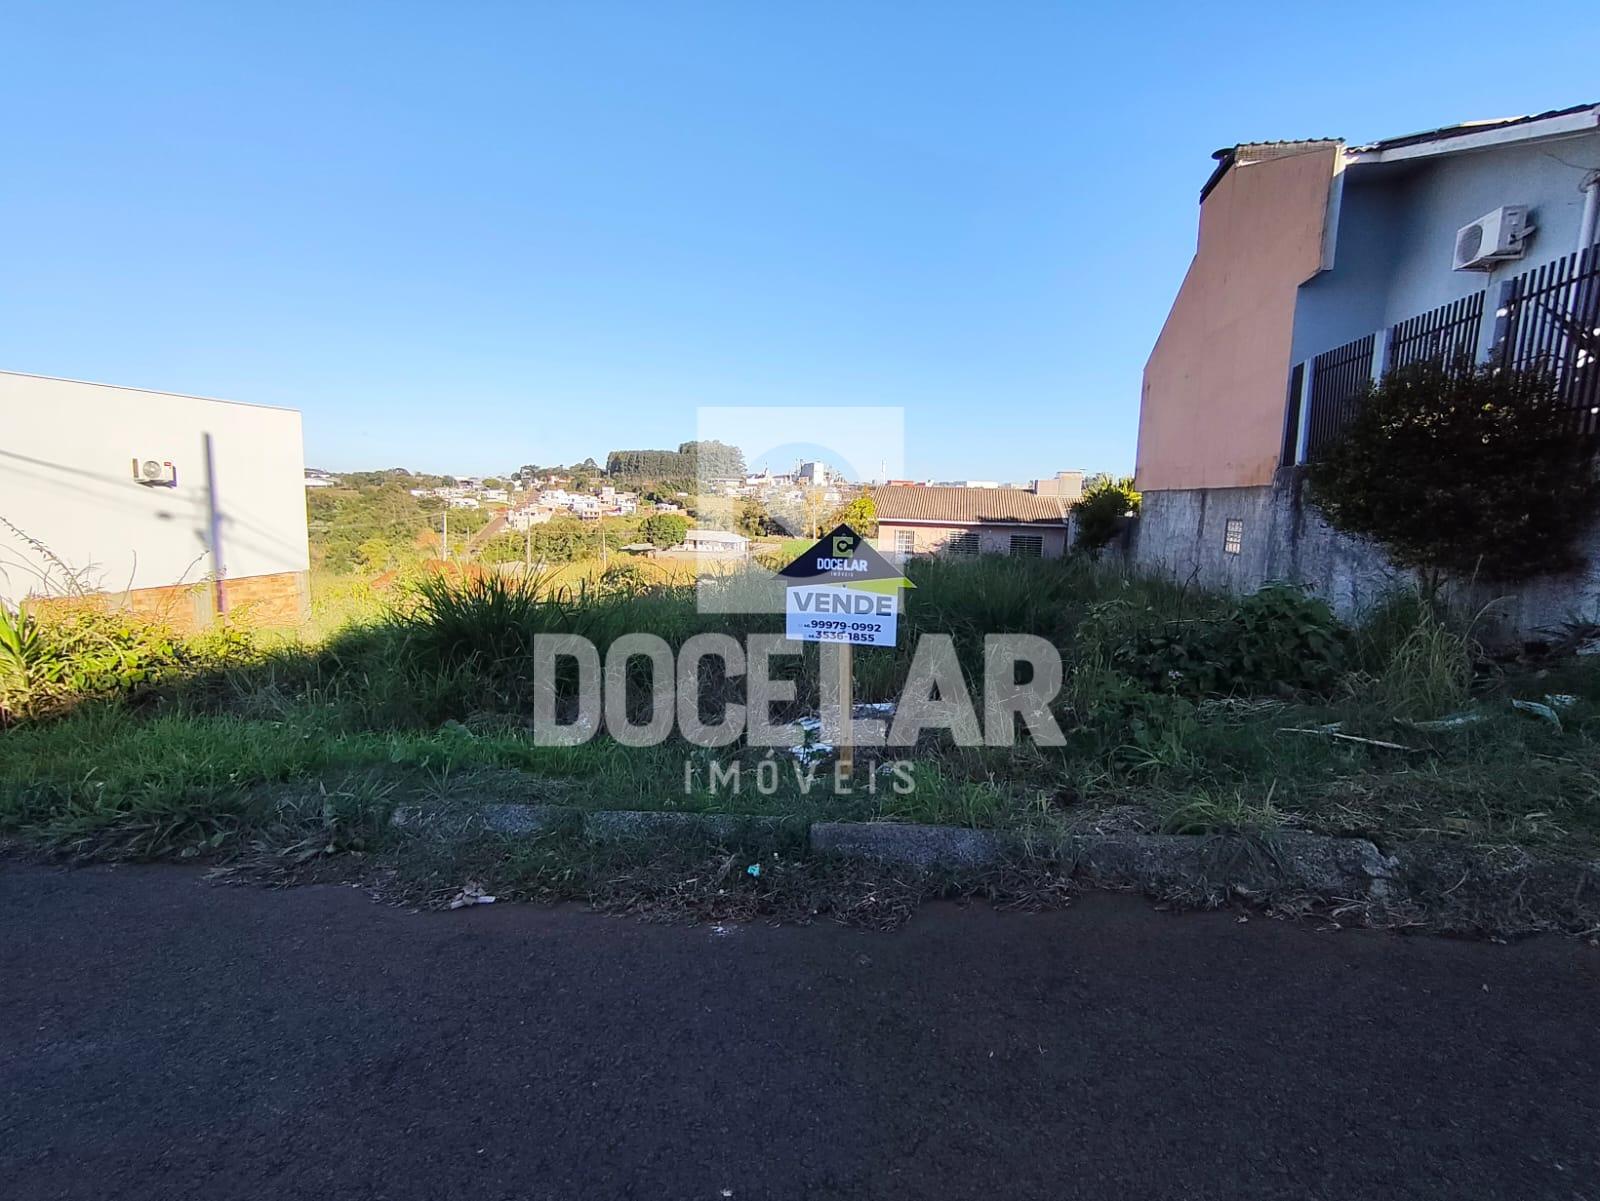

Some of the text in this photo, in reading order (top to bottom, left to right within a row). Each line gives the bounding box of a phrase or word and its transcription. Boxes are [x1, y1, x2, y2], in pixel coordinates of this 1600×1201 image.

[817, 558, 868, 571] DOCELAR
[793, 592, 892, 616] VENDE
[811, 620, 882, 632] 99979-0992
[816, 630, 875, 642] 3536-1855
